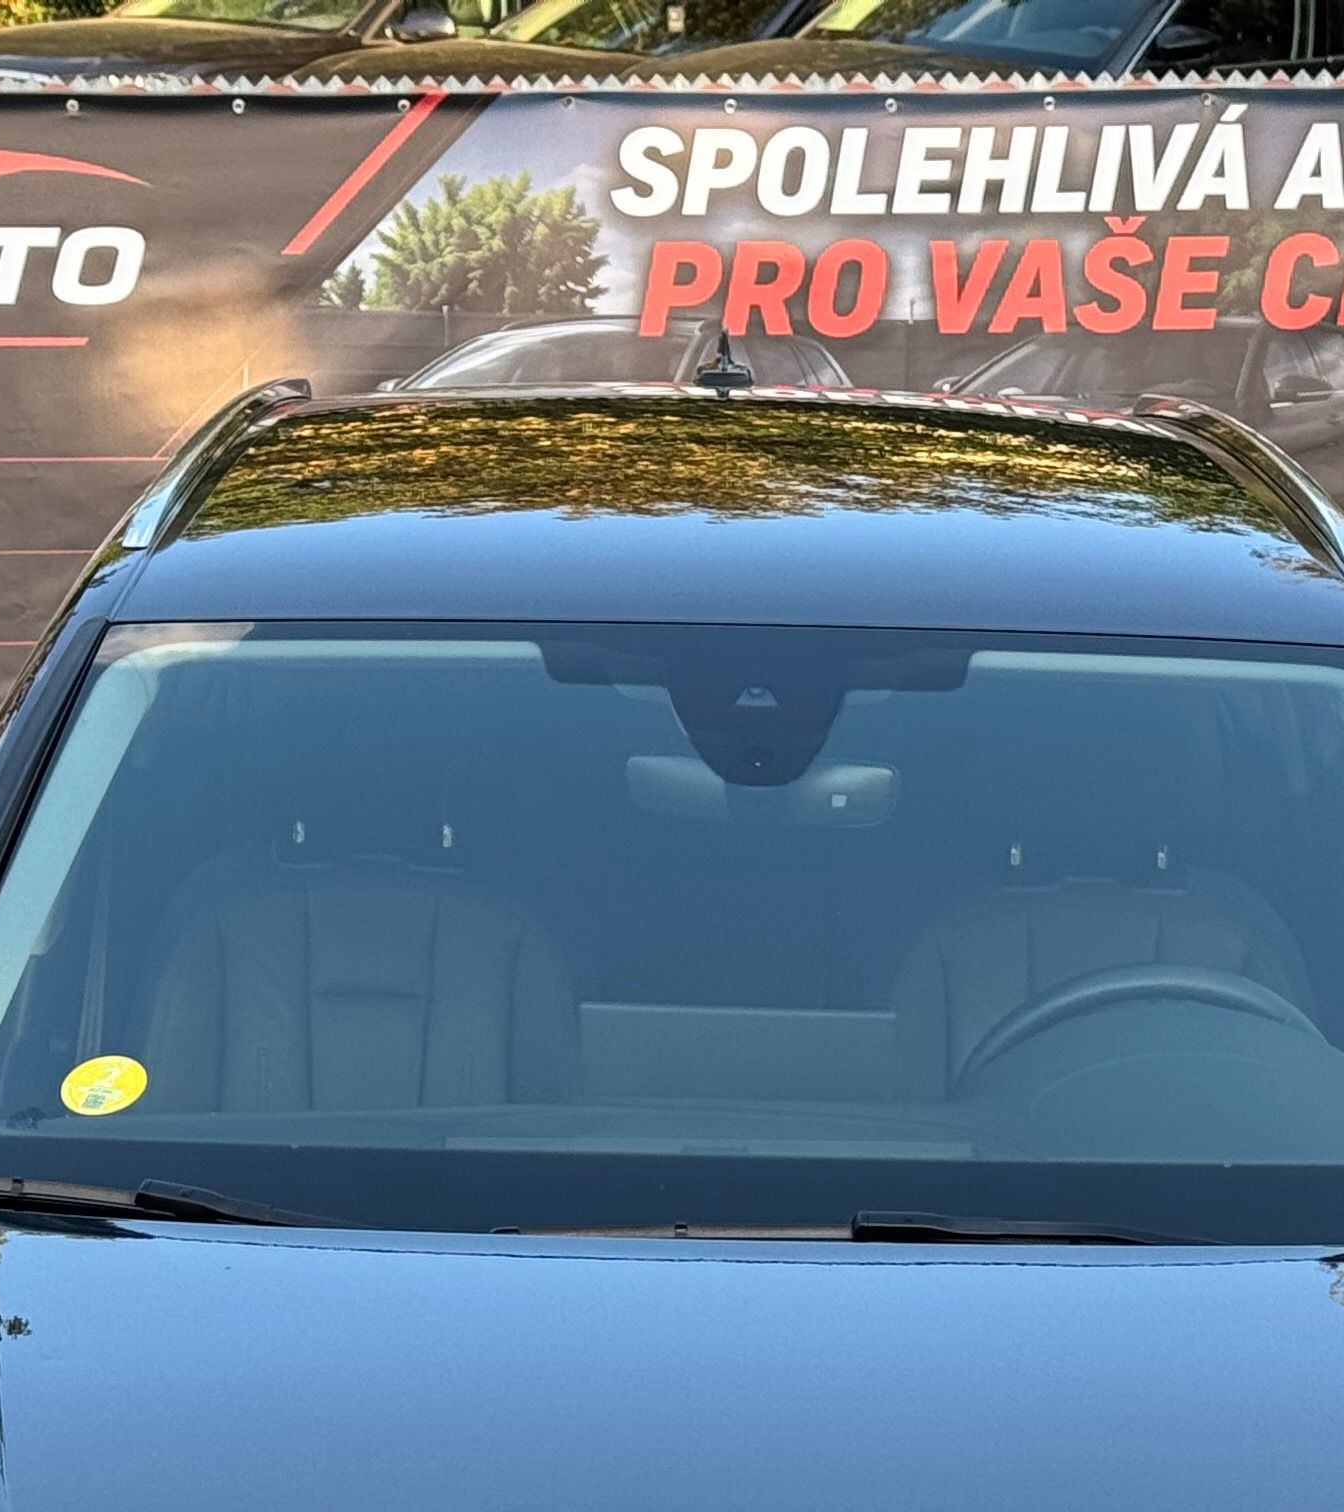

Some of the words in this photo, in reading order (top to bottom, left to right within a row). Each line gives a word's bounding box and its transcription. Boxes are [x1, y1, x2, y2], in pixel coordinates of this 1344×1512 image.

[609, 103, 1250, 217] SPOLEHLIVÁ
[639, 239, 888, 339] PRO
[929, 215, 1229, 334] VAŠE
